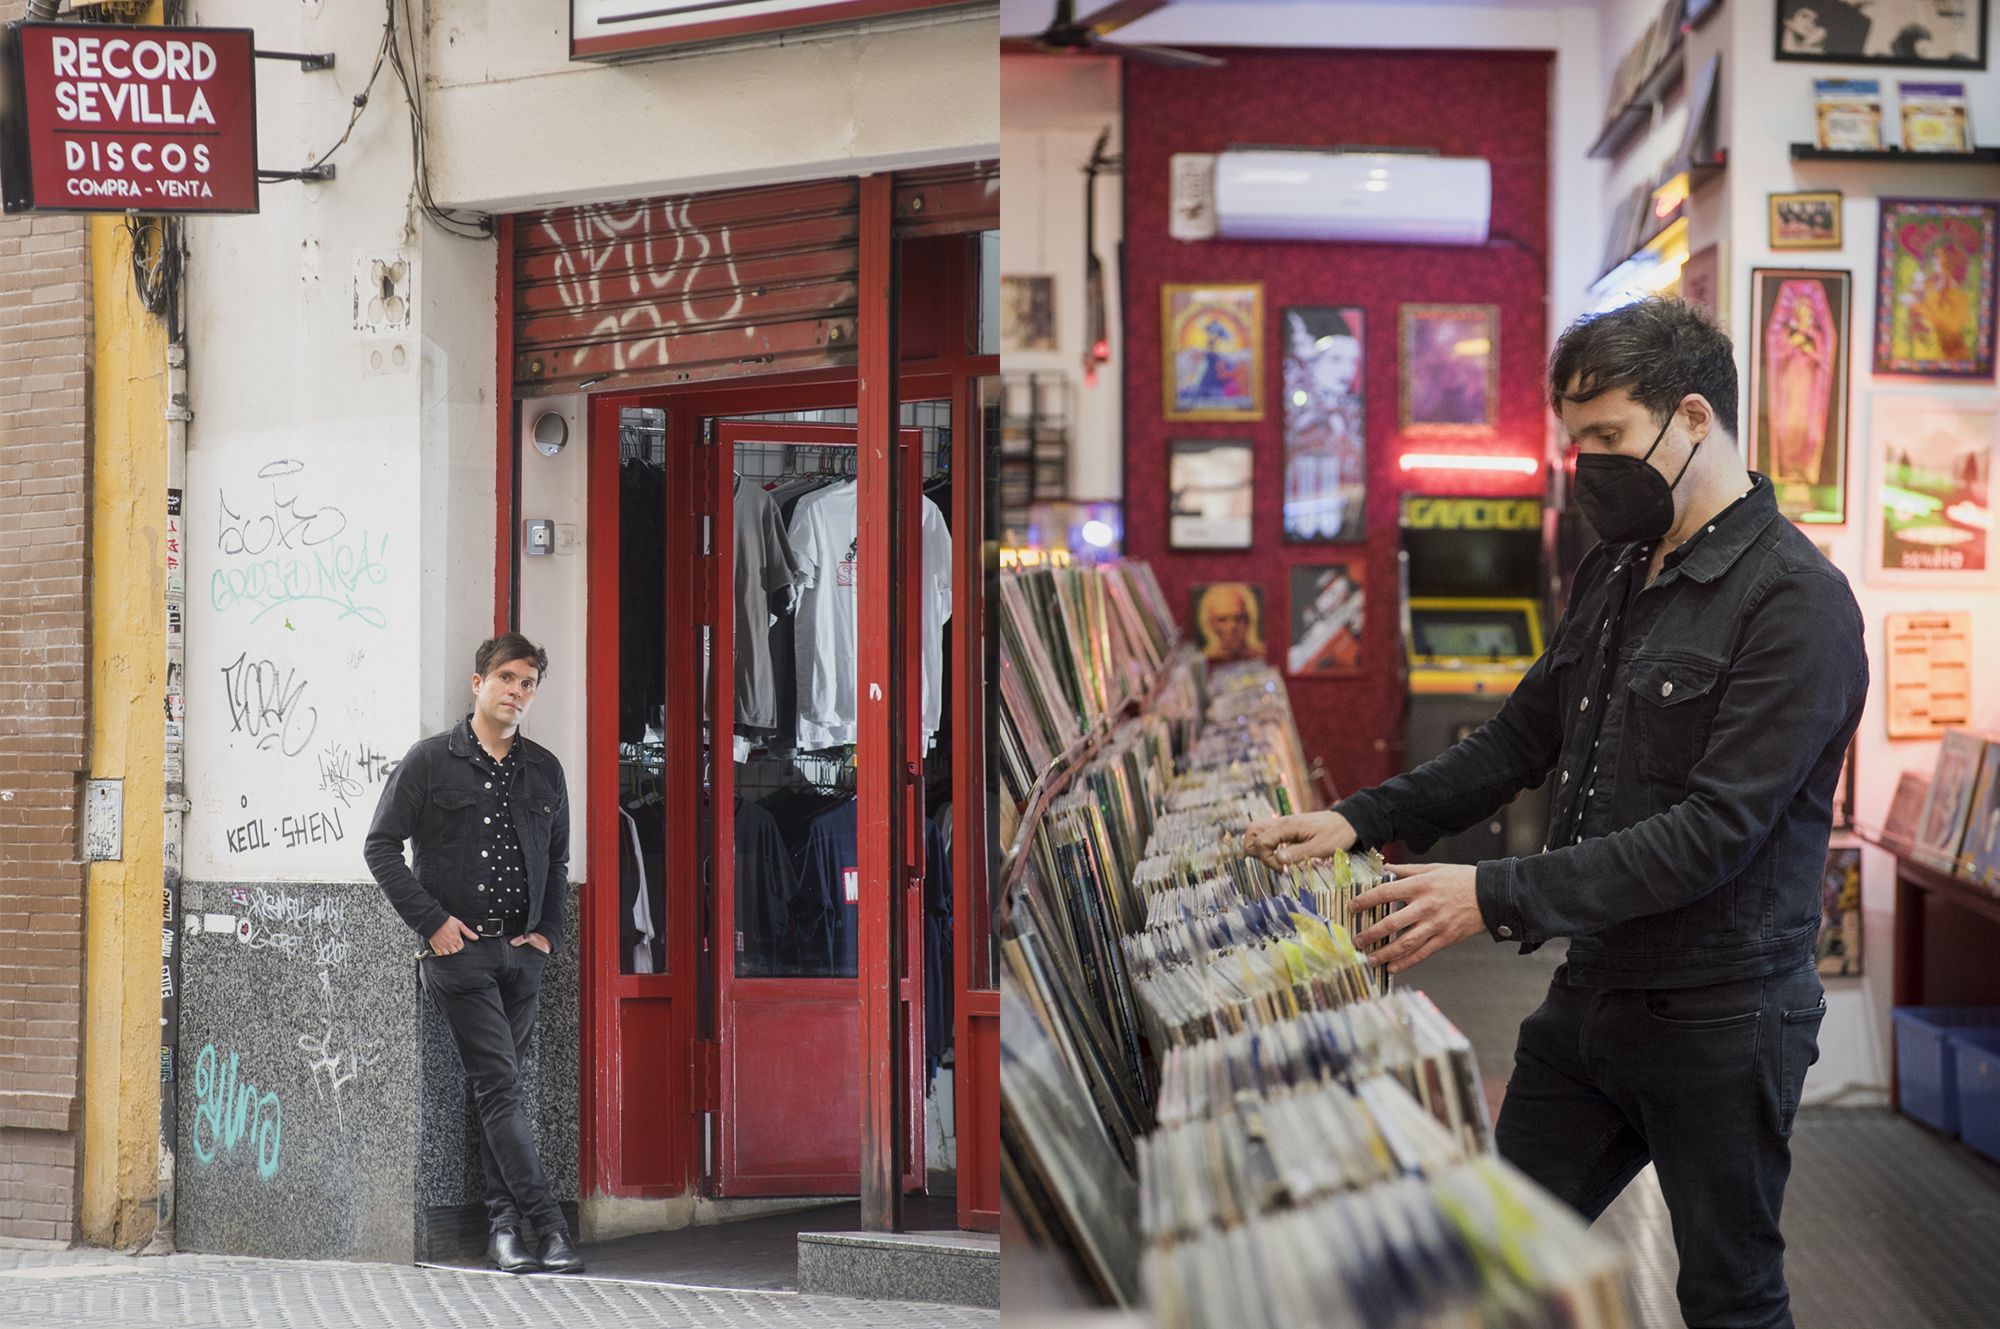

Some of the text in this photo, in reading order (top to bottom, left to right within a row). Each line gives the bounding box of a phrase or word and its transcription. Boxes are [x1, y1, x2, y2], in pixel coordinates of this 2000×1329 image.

[52, 36, 217, 81] RECORD
[54, 81, 216, 124] SEVILLA
[64, 140, 211, 173] DISCOS
[66, 178, 142, 197] COMPRA
[156, 179, 213, 198] VENTA
